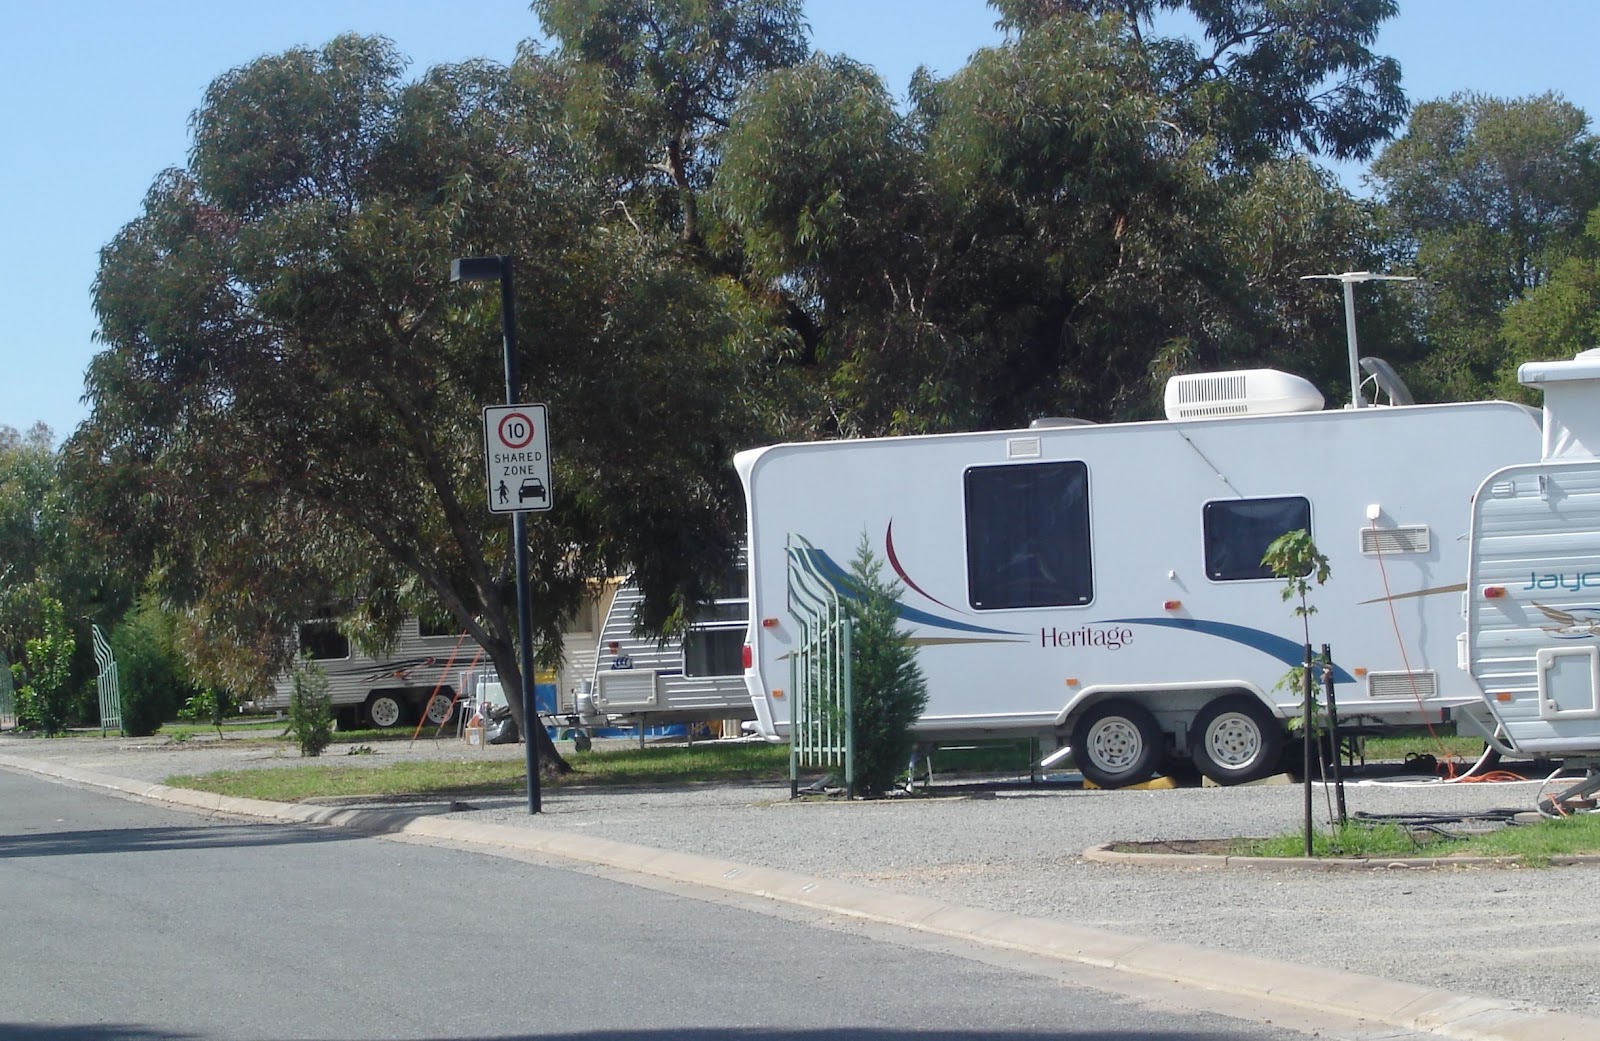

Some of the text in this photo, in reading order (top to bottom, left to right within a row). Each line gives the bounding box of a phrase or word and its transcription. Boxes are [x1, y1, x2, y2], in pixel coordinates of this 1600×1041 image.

[508, 423, 524, 438] 10
[495, 452, 542, 463] SHARED
[503, 465, 534, 476] ZONE
[1041, 626, 1133, 651] Heritage
